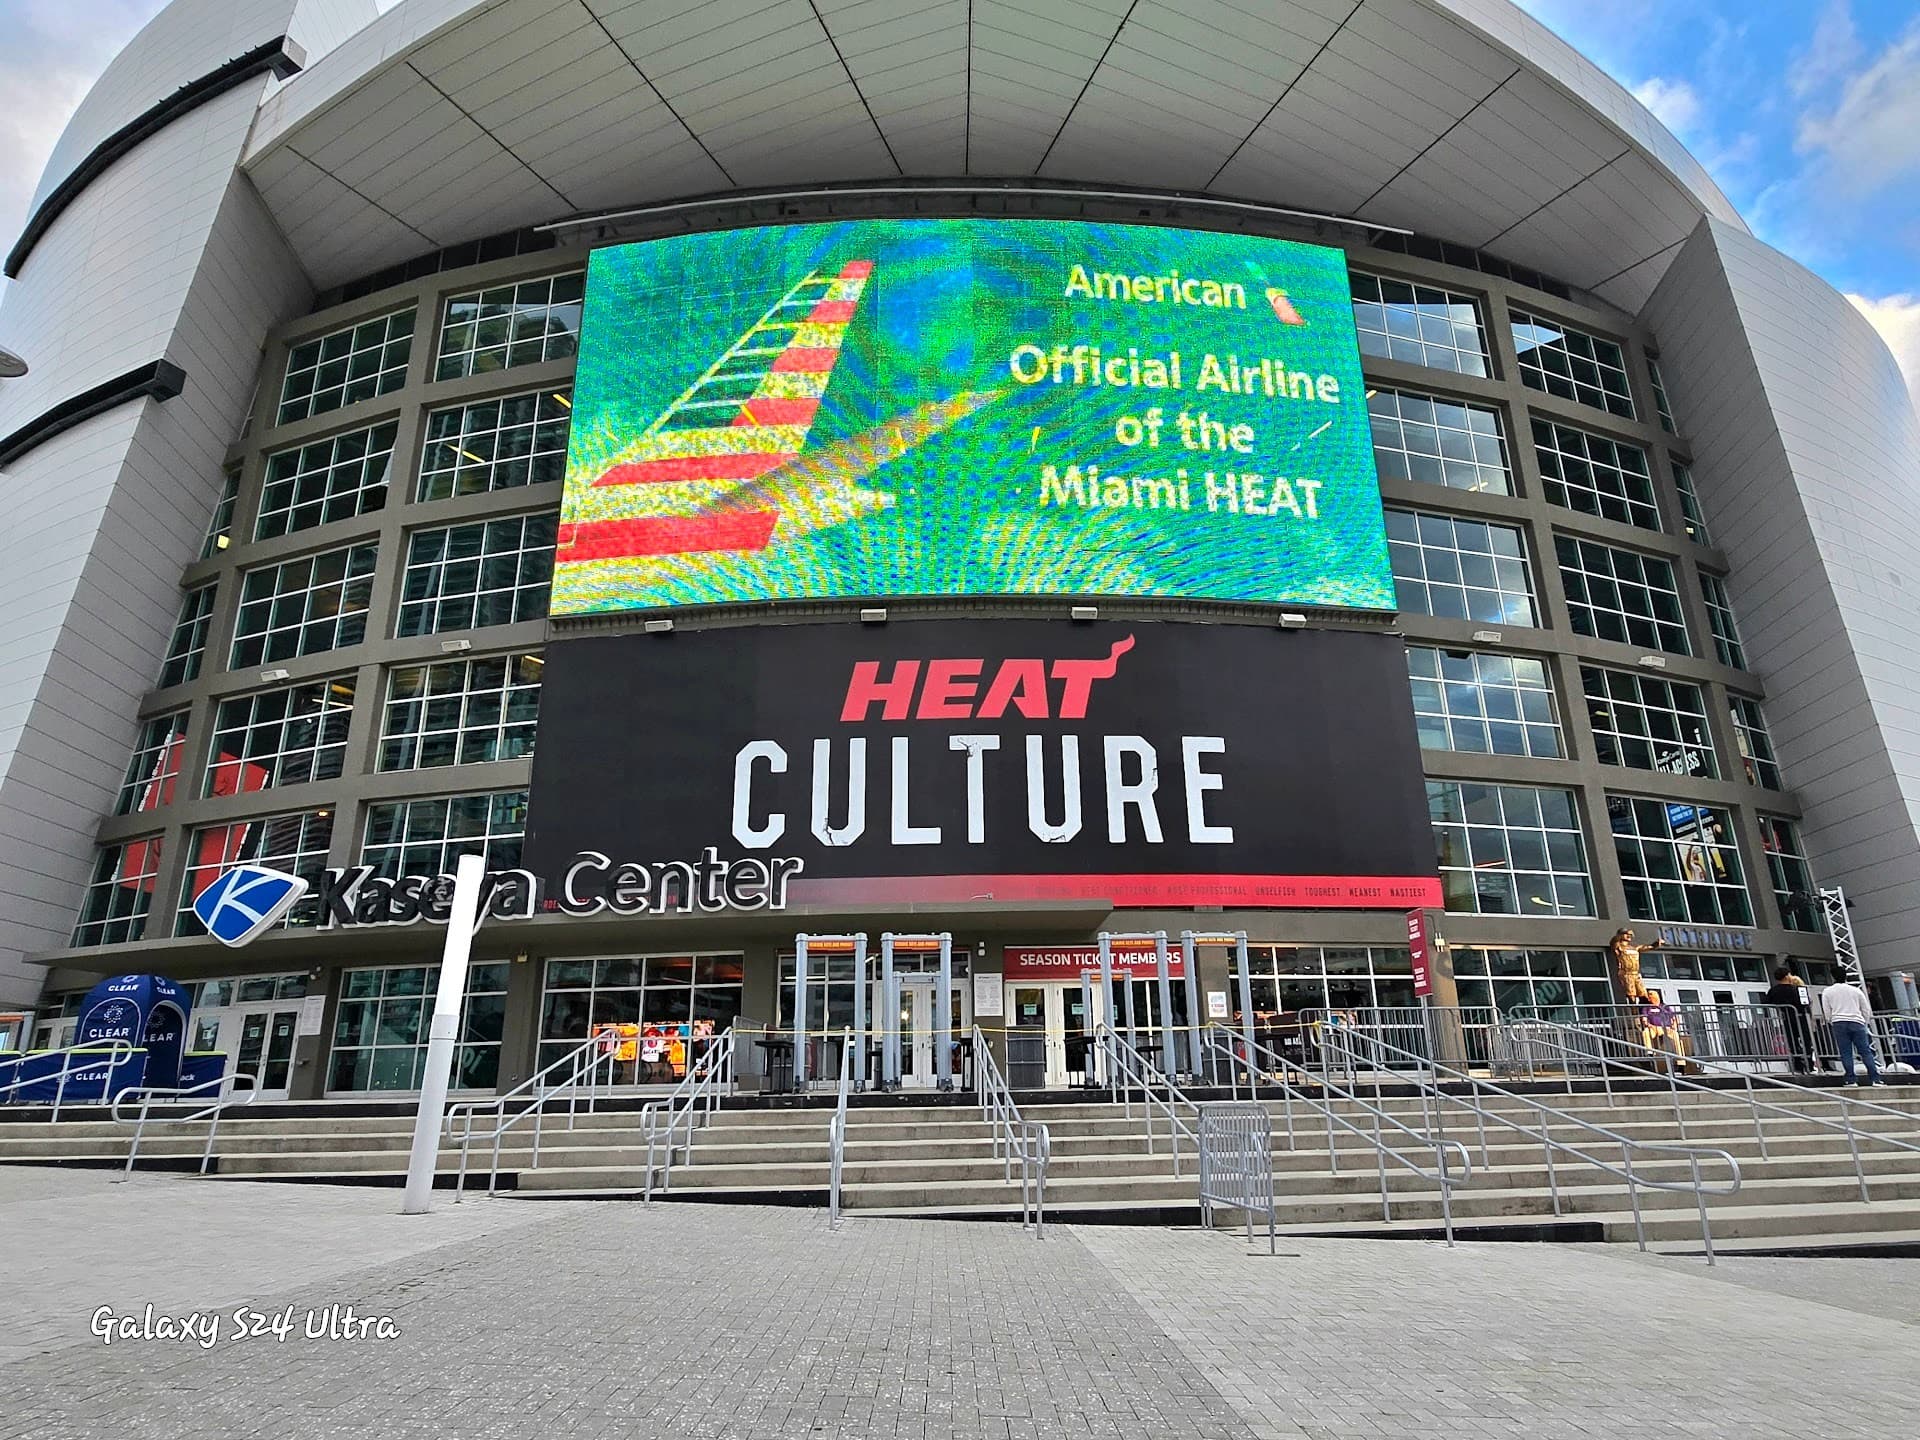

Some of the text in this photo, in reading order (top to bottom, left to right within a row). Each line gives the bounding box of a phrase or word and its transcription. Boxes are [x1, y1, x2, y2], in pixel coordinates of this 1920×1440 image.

[1064, 264, 1246, 309] American
[1010, 344, 1341, 404] Official Airline
[1116, 407, 1255, 453] of the
[1039, 464, 1322, 519] Miami HEAT
[839, 633, 1135, 722] HEAT
[731, 734, 1234, 849] CULTURE
[558, 846, 804, 917] Center
[1256, 886, 1296, 897] UNSELFISH
[1305, 887, 1341, 897] TOUGHEST
[1350, 887, 1382, 897] MEANEST
[1390, 887, 1427, 898] NASTIEST
[1657, 926, 1753, 951] ENTRANCE
[1020, 951, 1182, 966] SEASON TICKT MEMBRS
[108, 984, 139, 992] CLEAR
[89, 1028, 129, 1038] CLEAR
[143, 1033, 173, 1042] LEAR
[75, 1072, 109, 1081] CLEAR
